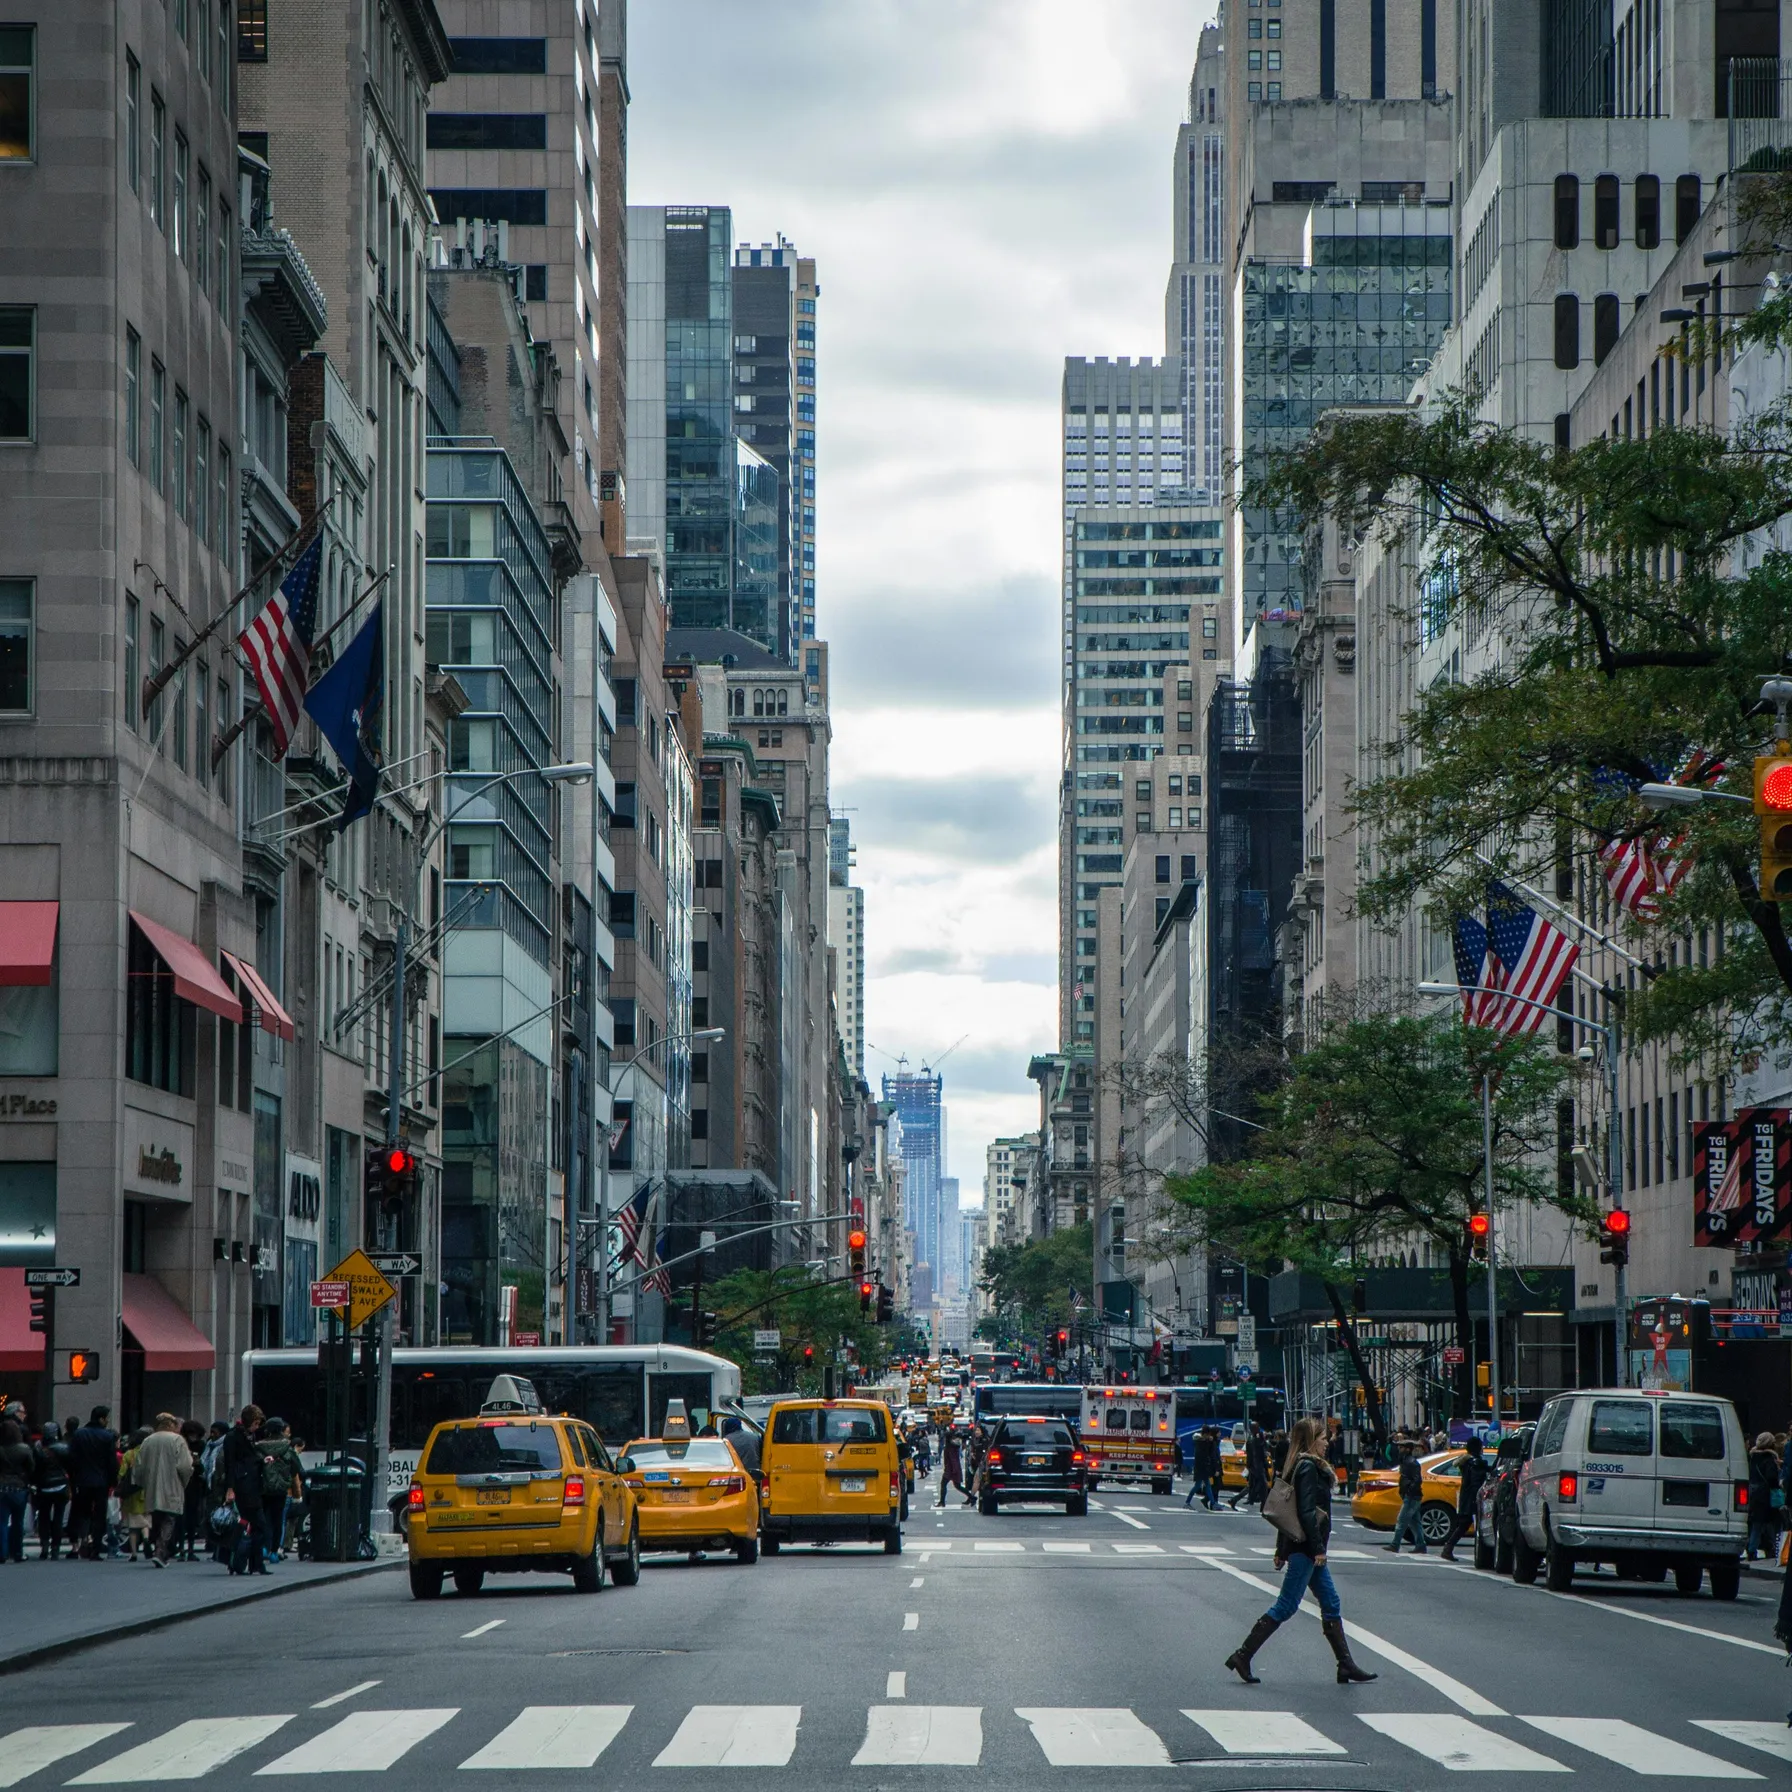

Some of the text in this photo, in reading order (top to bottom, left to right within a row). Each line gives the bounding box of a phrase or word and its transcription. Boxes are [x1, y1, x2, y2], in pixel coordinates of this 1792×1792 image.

[10, 1094, 57, 1115] Place
[1755, 1124, 1774, 1134] TGI
[1709, 1136, 1726, 1146] TGI
[1755, 1135, 1775, 1225] FRIDAYS
[1709, 1147, 1727, 1232] FRIDYS
[289, 1171, 321, 1223] ALDO
[391, 1260, 412, 1269] WAY
[32, 1273, 72, 1281] ONE WAY
[332, 1273, 381, 1284] RECESSED
[360, 1298, 377, 1307] AVE
[662, 1362, 668, 1370] 8
[492, 1402, 511, 1411] 4L46
[1106, 1428, 1149, 1437] AMBULANCE
[1586, 1462, 1624, 1474] 6933015
